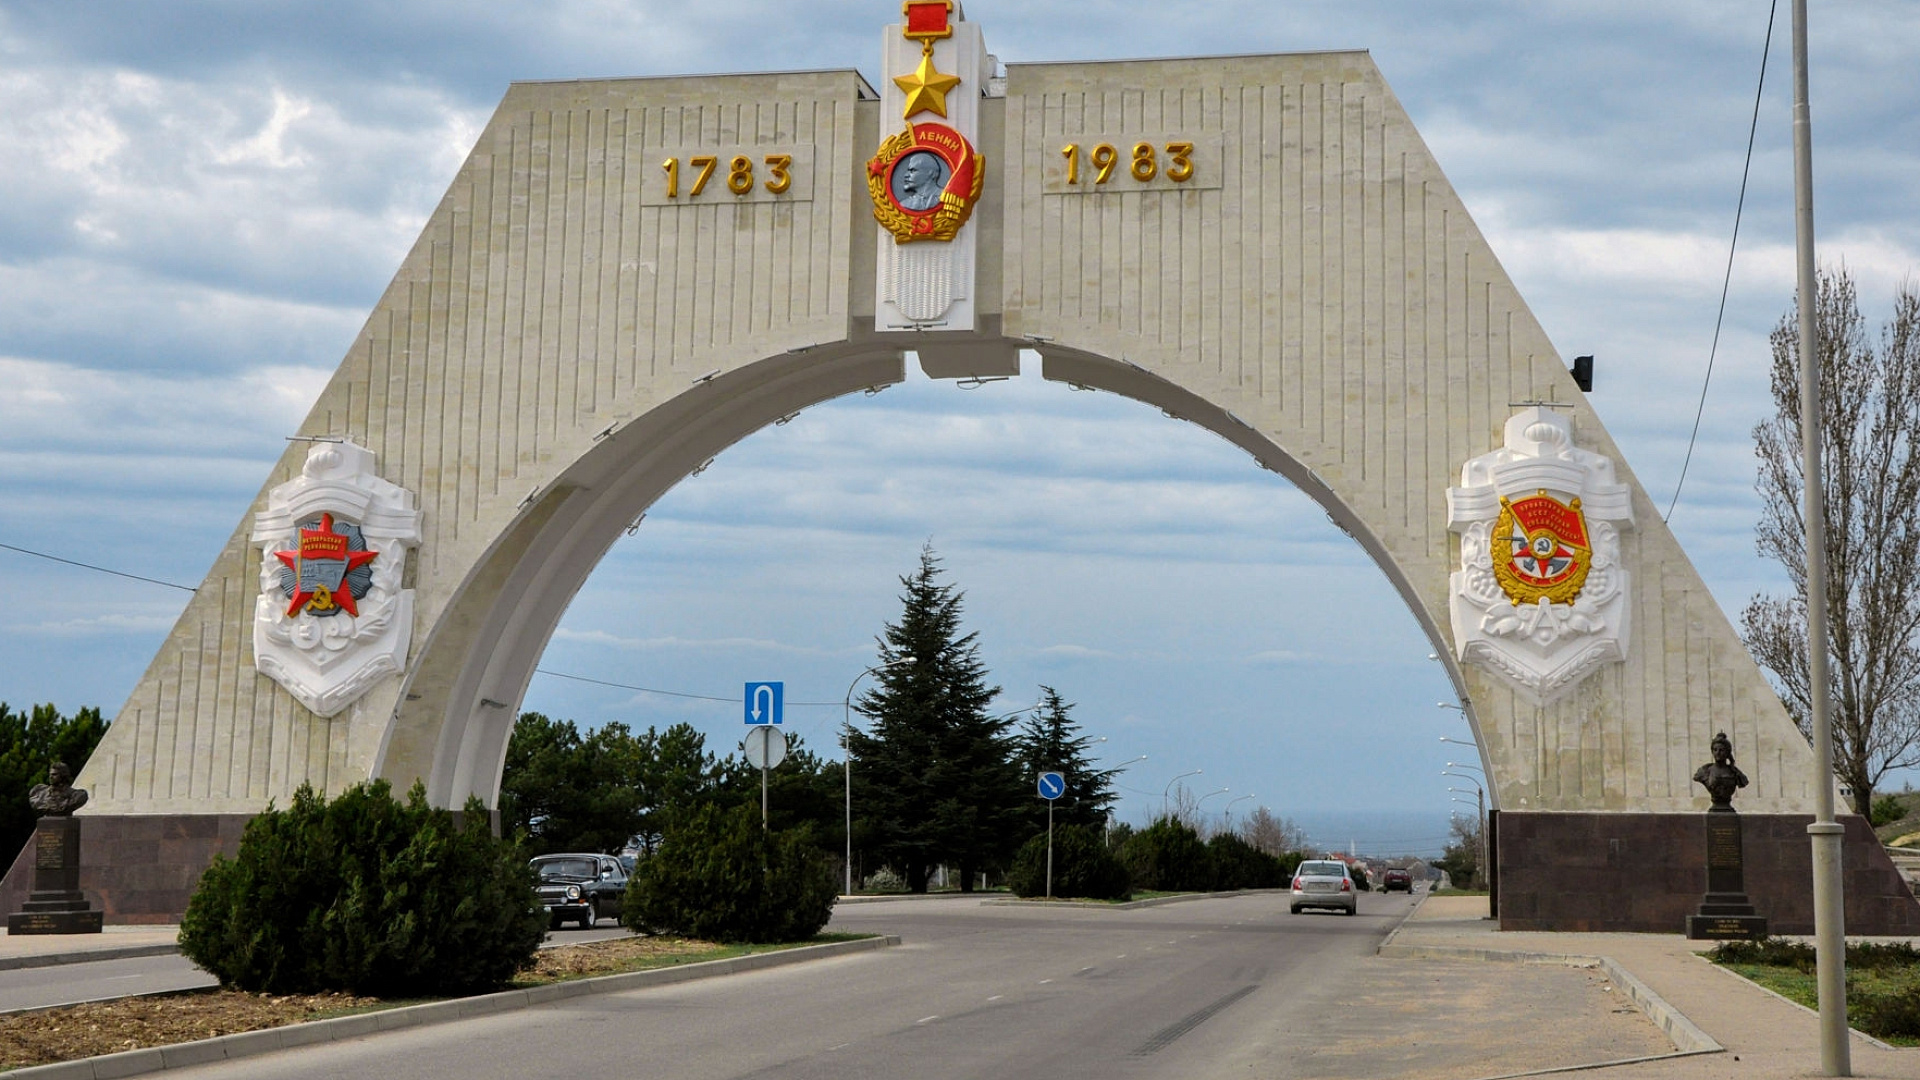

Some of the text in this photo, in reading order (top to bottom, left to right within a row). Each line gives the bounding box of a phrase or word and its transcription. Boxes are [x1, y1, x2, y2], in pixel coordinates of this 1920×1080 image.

[919, 131, 960, 152] ЛЕНИН
[662, 154, 792, 198] 1783
[1062, 142, 1194, 185] 1983
